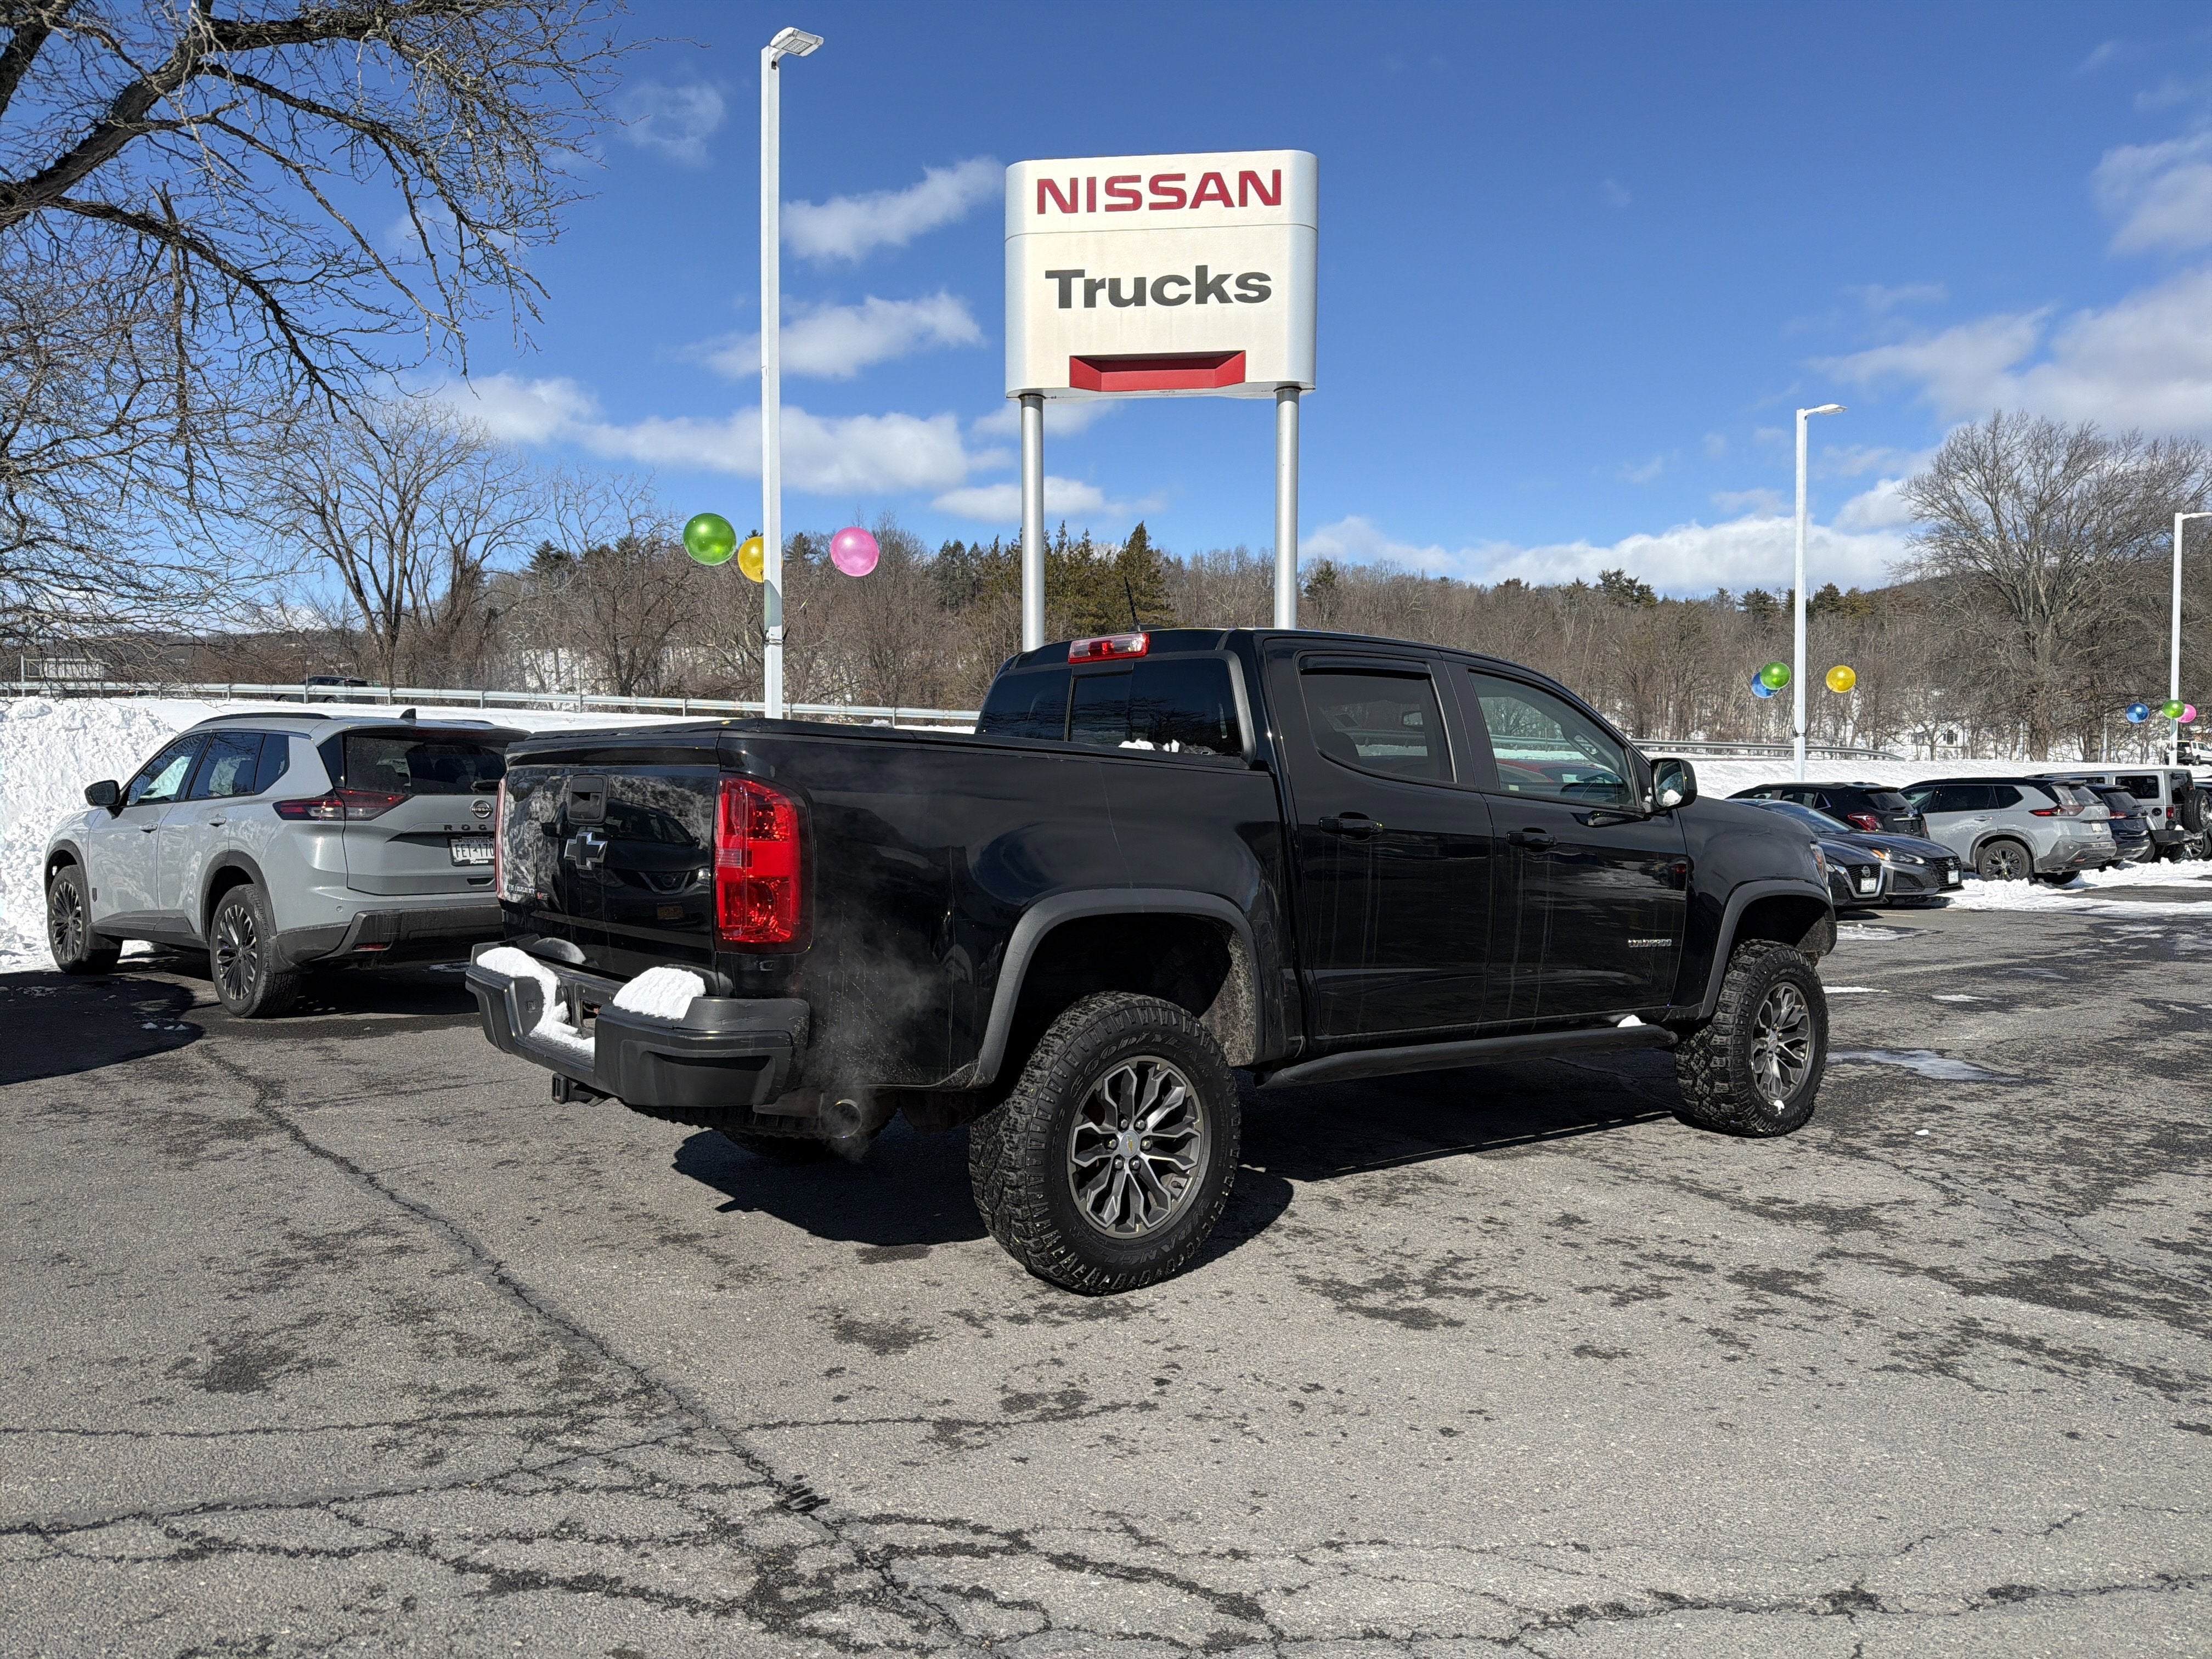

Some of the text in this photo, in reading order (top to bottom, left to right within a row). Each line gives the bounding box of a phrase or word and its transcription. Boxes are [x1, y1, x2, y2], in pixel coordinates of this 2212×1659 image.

[1037, 169, 1282, 215] NISSAN
[1045, 264, 1272, 309] Trucks
[478, 843, 494, 857] 170
